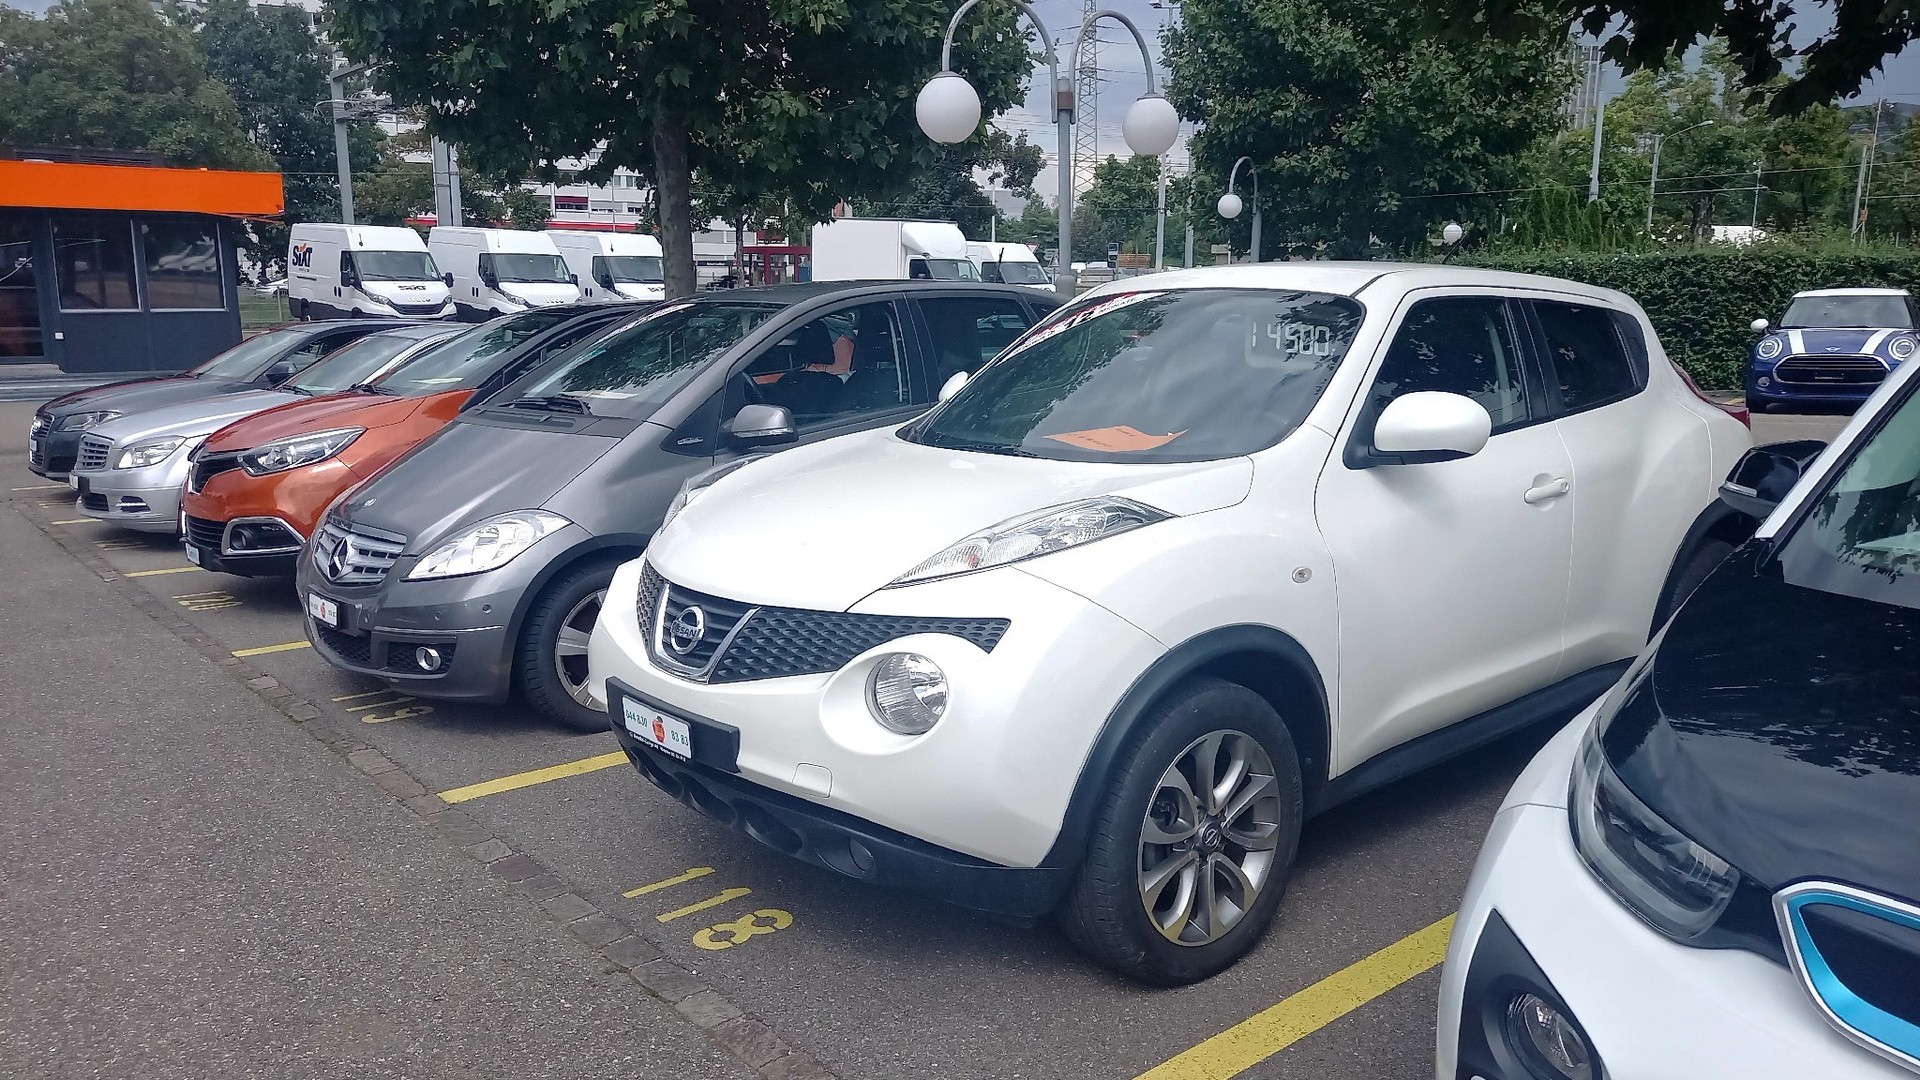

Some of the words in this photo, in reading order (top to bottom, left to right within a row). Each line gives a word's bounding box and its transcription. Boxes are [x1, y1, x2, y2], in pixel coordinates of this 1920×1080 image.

[292, 243, 312, 267] SIXT
[672, 622, 697, 638] SSAN
[671, 730, 680, 743] 83
[680, 734, 689, 746] 83
[622, 866, 794, 951] 118
